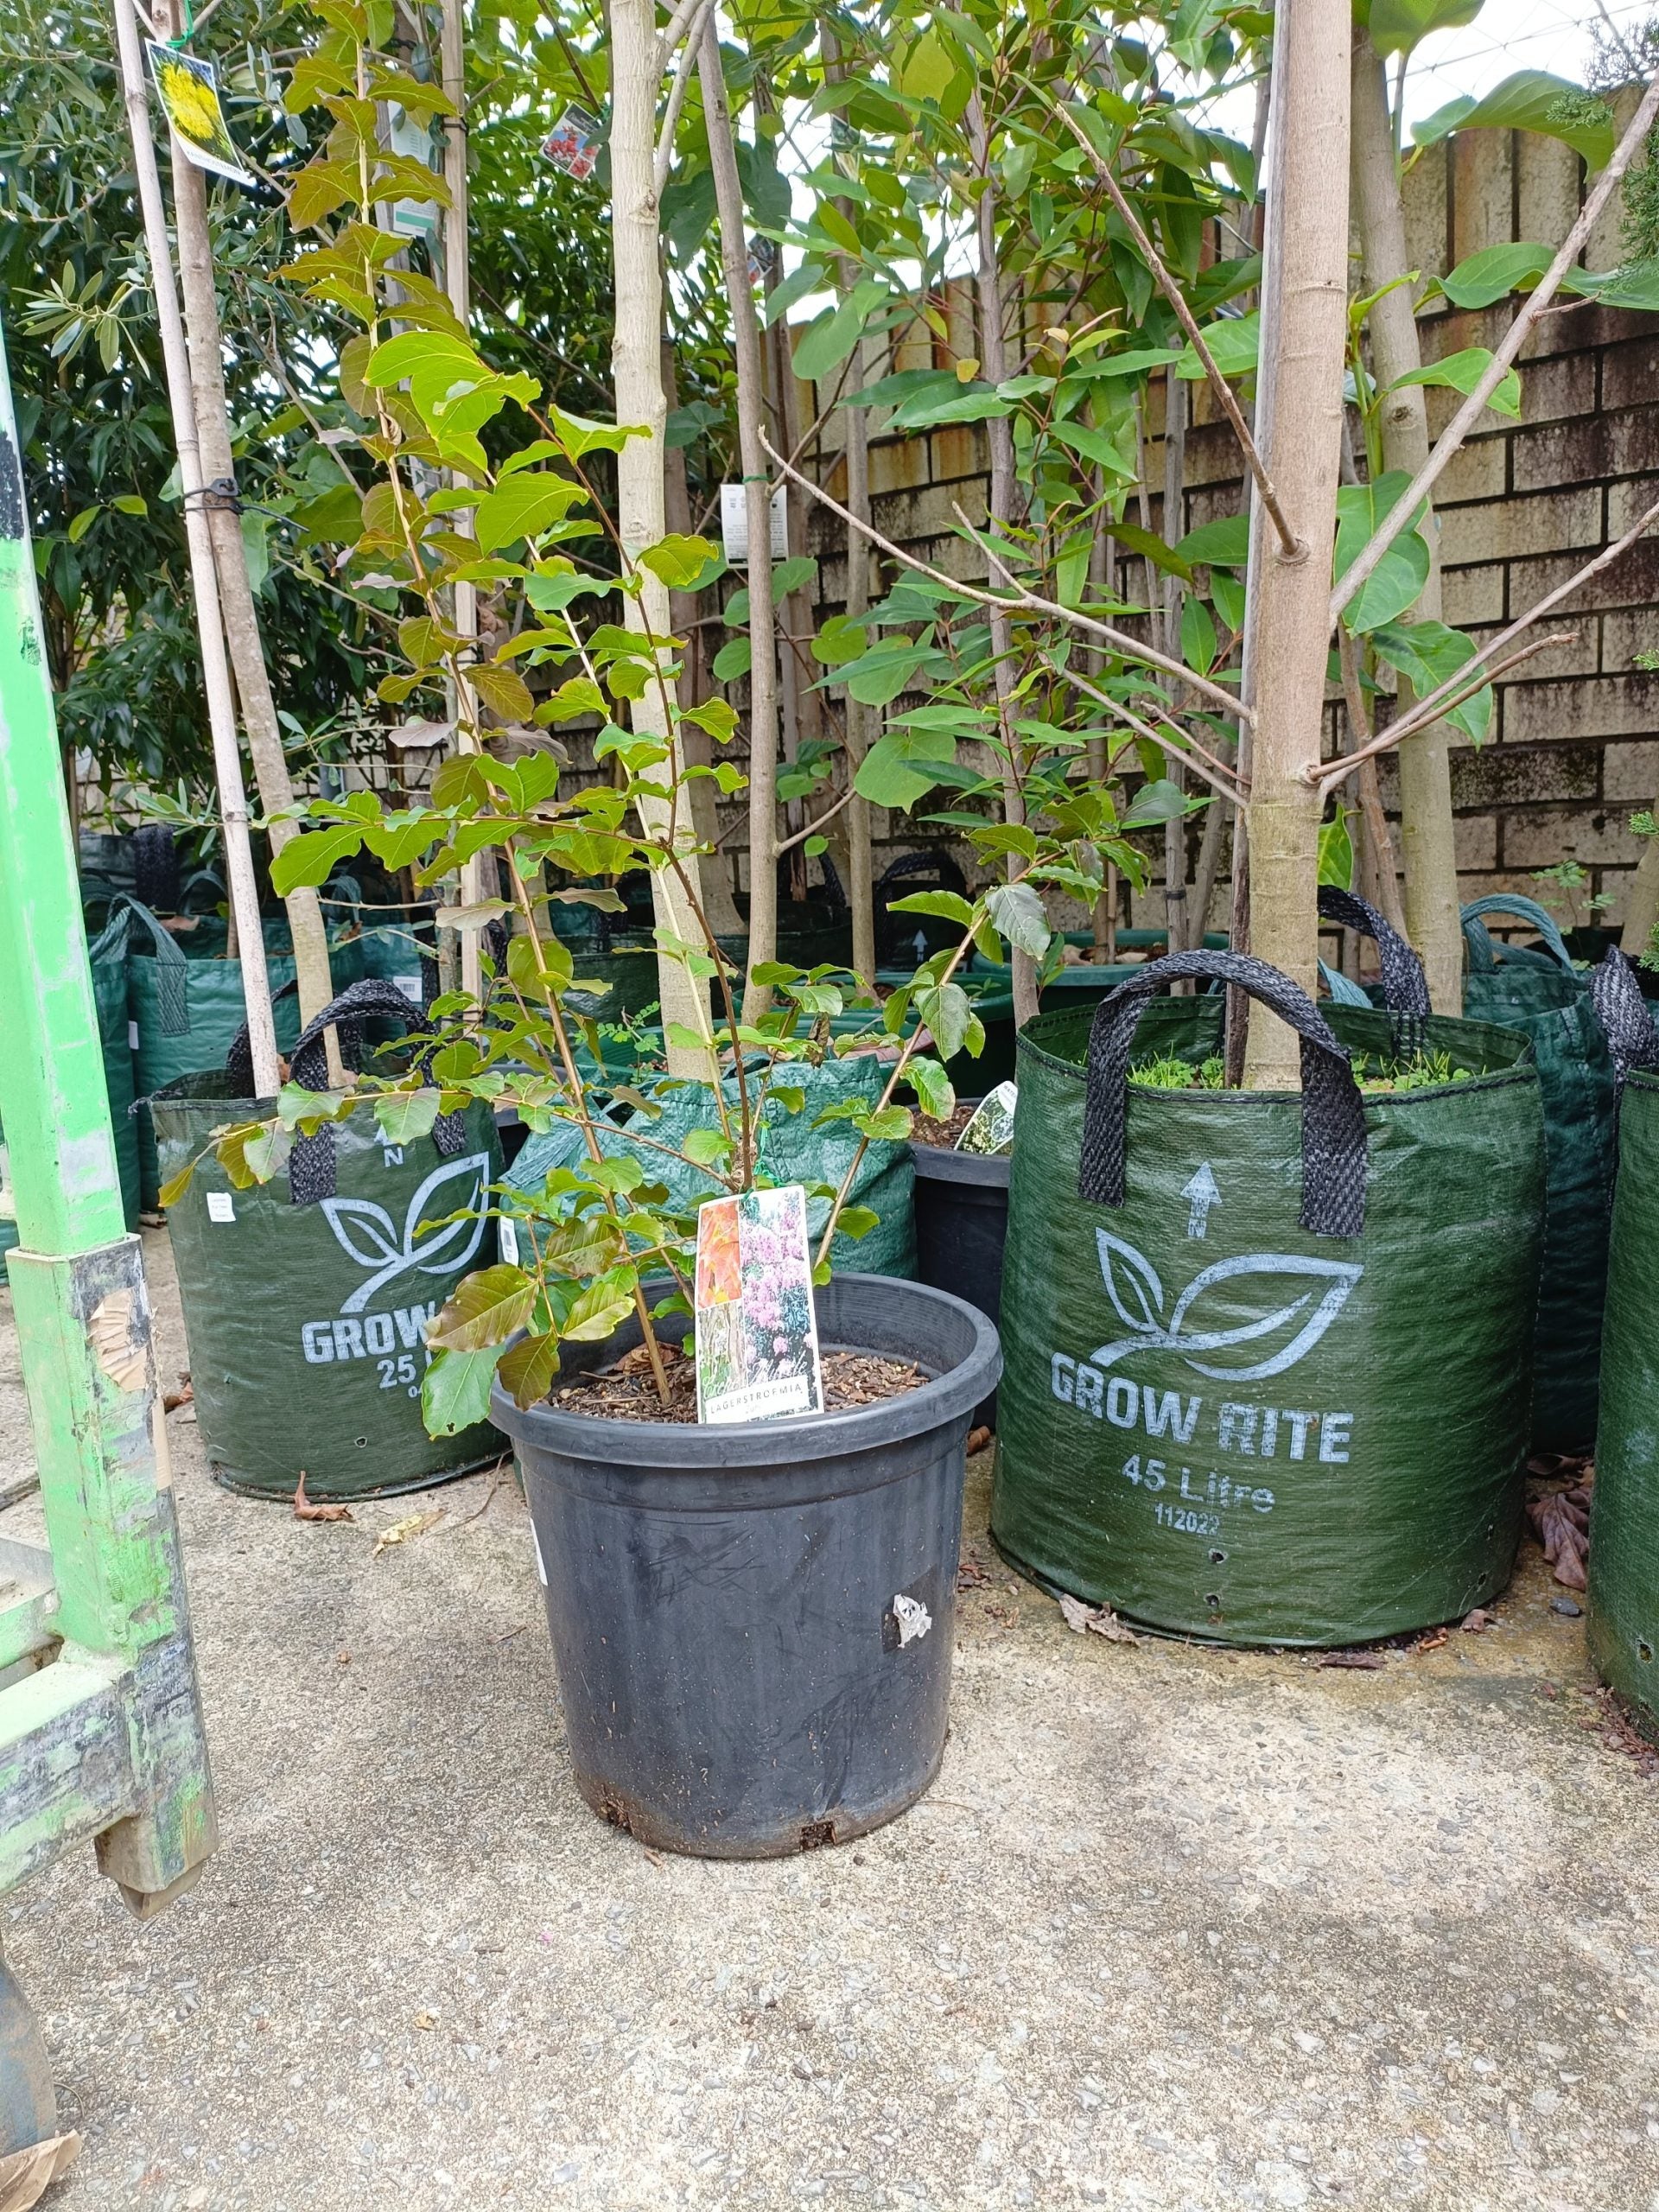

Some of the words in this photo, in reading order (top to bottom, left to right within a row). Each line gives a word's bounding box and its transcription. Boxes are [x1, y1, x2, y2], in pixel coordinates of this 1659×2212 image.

[384, 1147, 404, 1167] N
[1187, 1217, 1207, 1238] N
[302, 1300, 435, 1363] GROW
[377, 1353, 416, 1389] 25
[710, 1382, 803, 1414] LAGERSTROEMIA
[1051, 1351, 1203, 1445] GROW
[1217, 1402, 1354, 1463] RITE
[1123, 1453, 1166, 1492] 45
[1179, 1467, 1275, 1513] Litre
[1154, 1503, 1220, 1535] 112022
